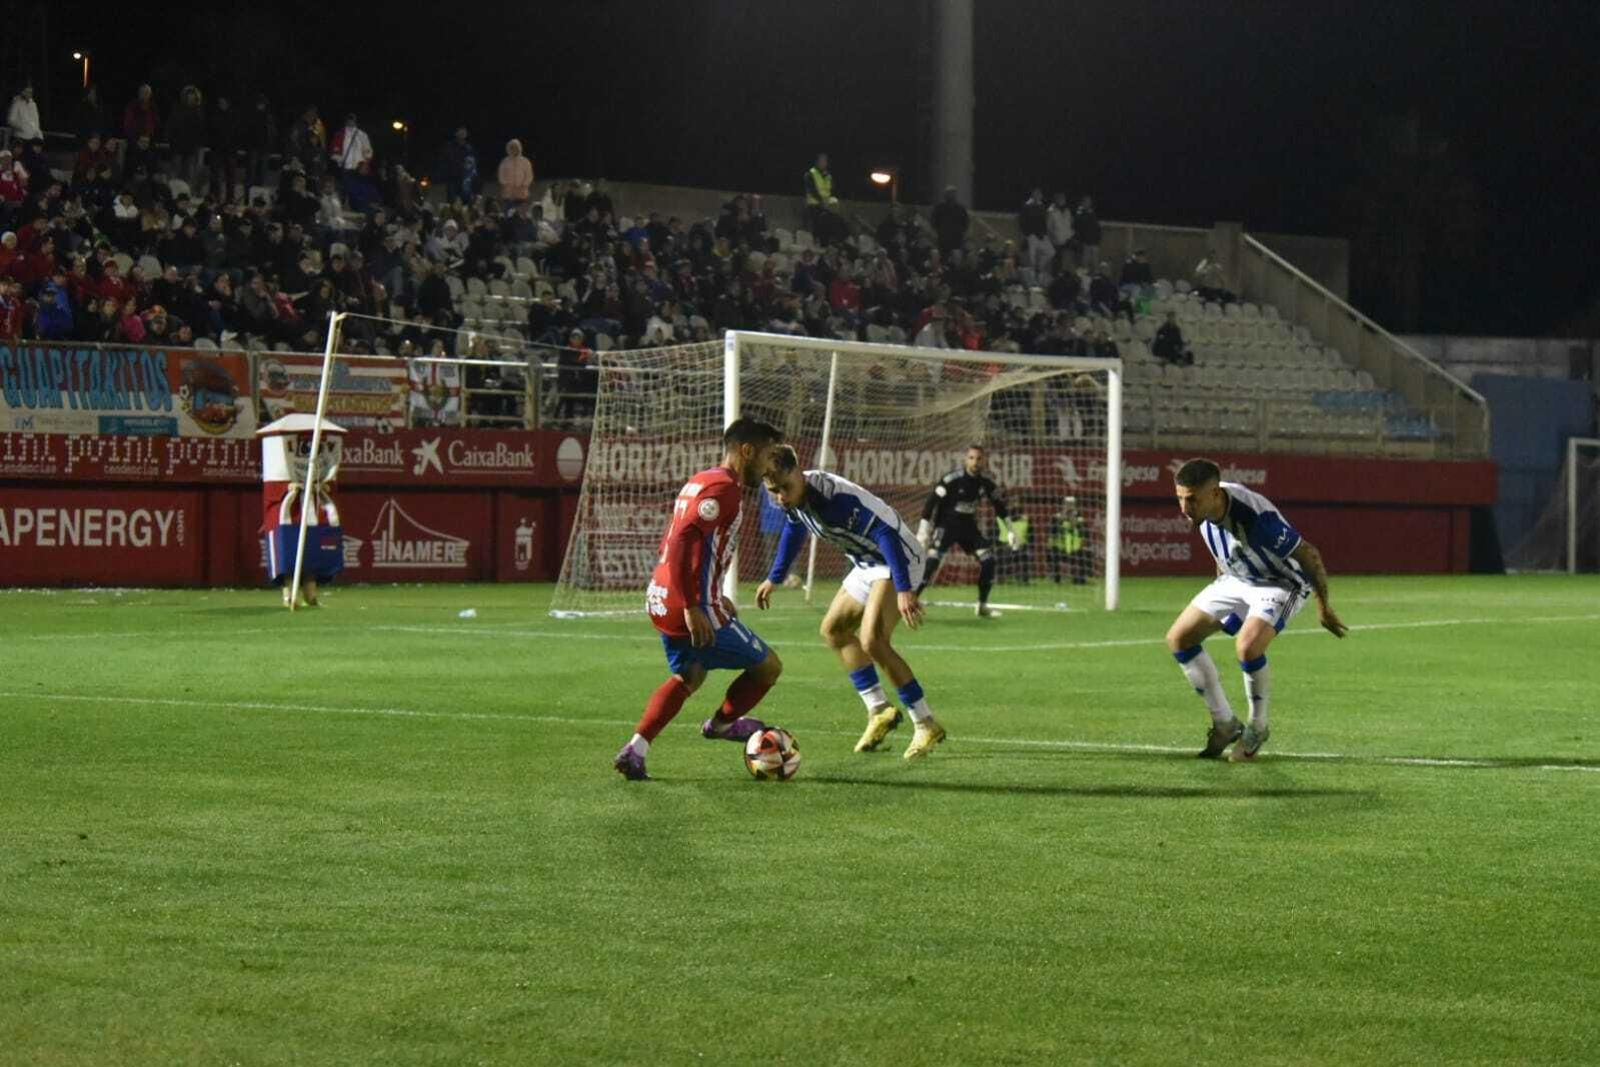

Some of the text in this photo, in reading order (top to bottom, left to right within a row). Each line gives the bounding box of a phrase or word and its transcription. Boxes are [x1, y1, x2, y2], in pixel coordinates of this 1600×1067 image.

[343, 438, 404, 464] xaBank
[449, 439, 535, 468] CaixaBank
[590, 442, 721, 481] HORIZONT
[844, 450, 1033, 487] HORIZONT SUR
